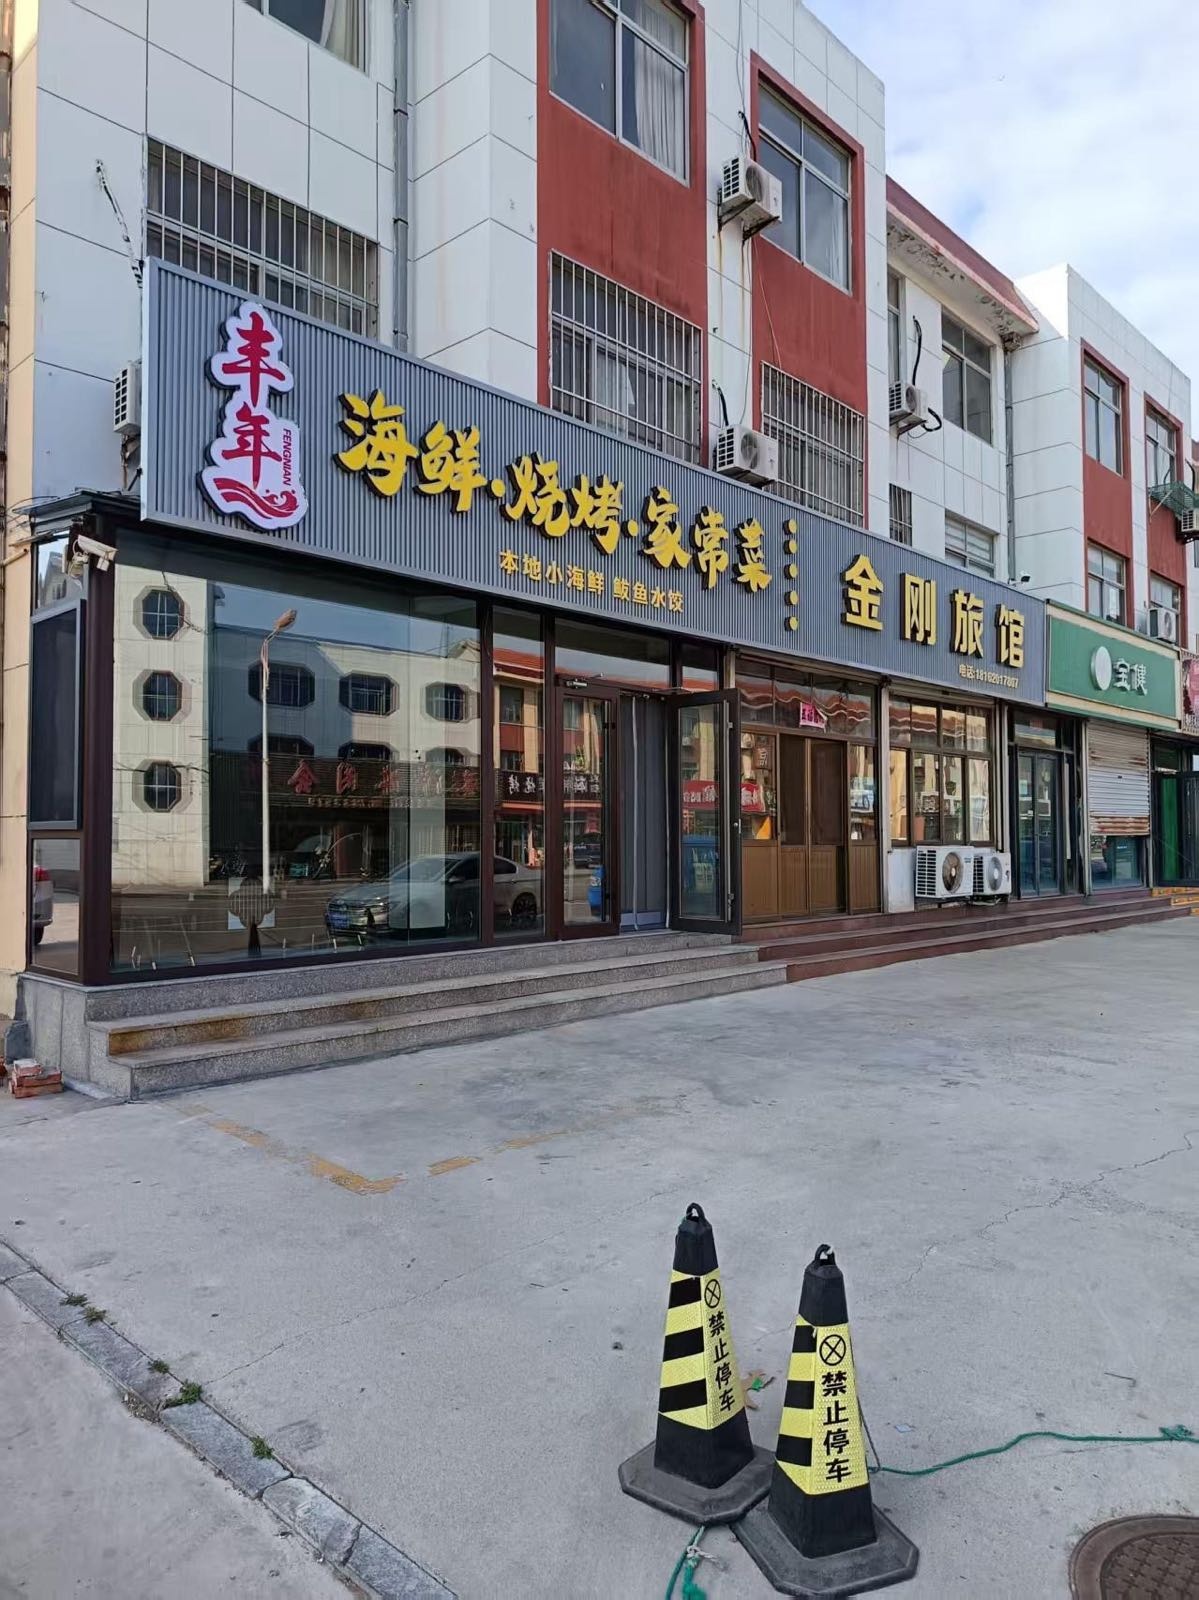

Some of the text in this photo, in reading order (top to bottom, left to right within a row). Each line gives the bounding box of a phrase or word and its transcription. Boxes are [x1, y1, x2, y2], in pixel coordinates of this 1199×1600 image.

[221, 312, 286, 489] 丰年
[282, 428, 292, 487] FENGNIAN
[500, 549, 684, 614] 本地小海鲜 鲅鱼水饺
[841, 554, 1025, 669] 金刚旅馆
[708, 1311, 735, 1411] 禁止停车
[821, 1370, 852, 1484] 禁止停车
